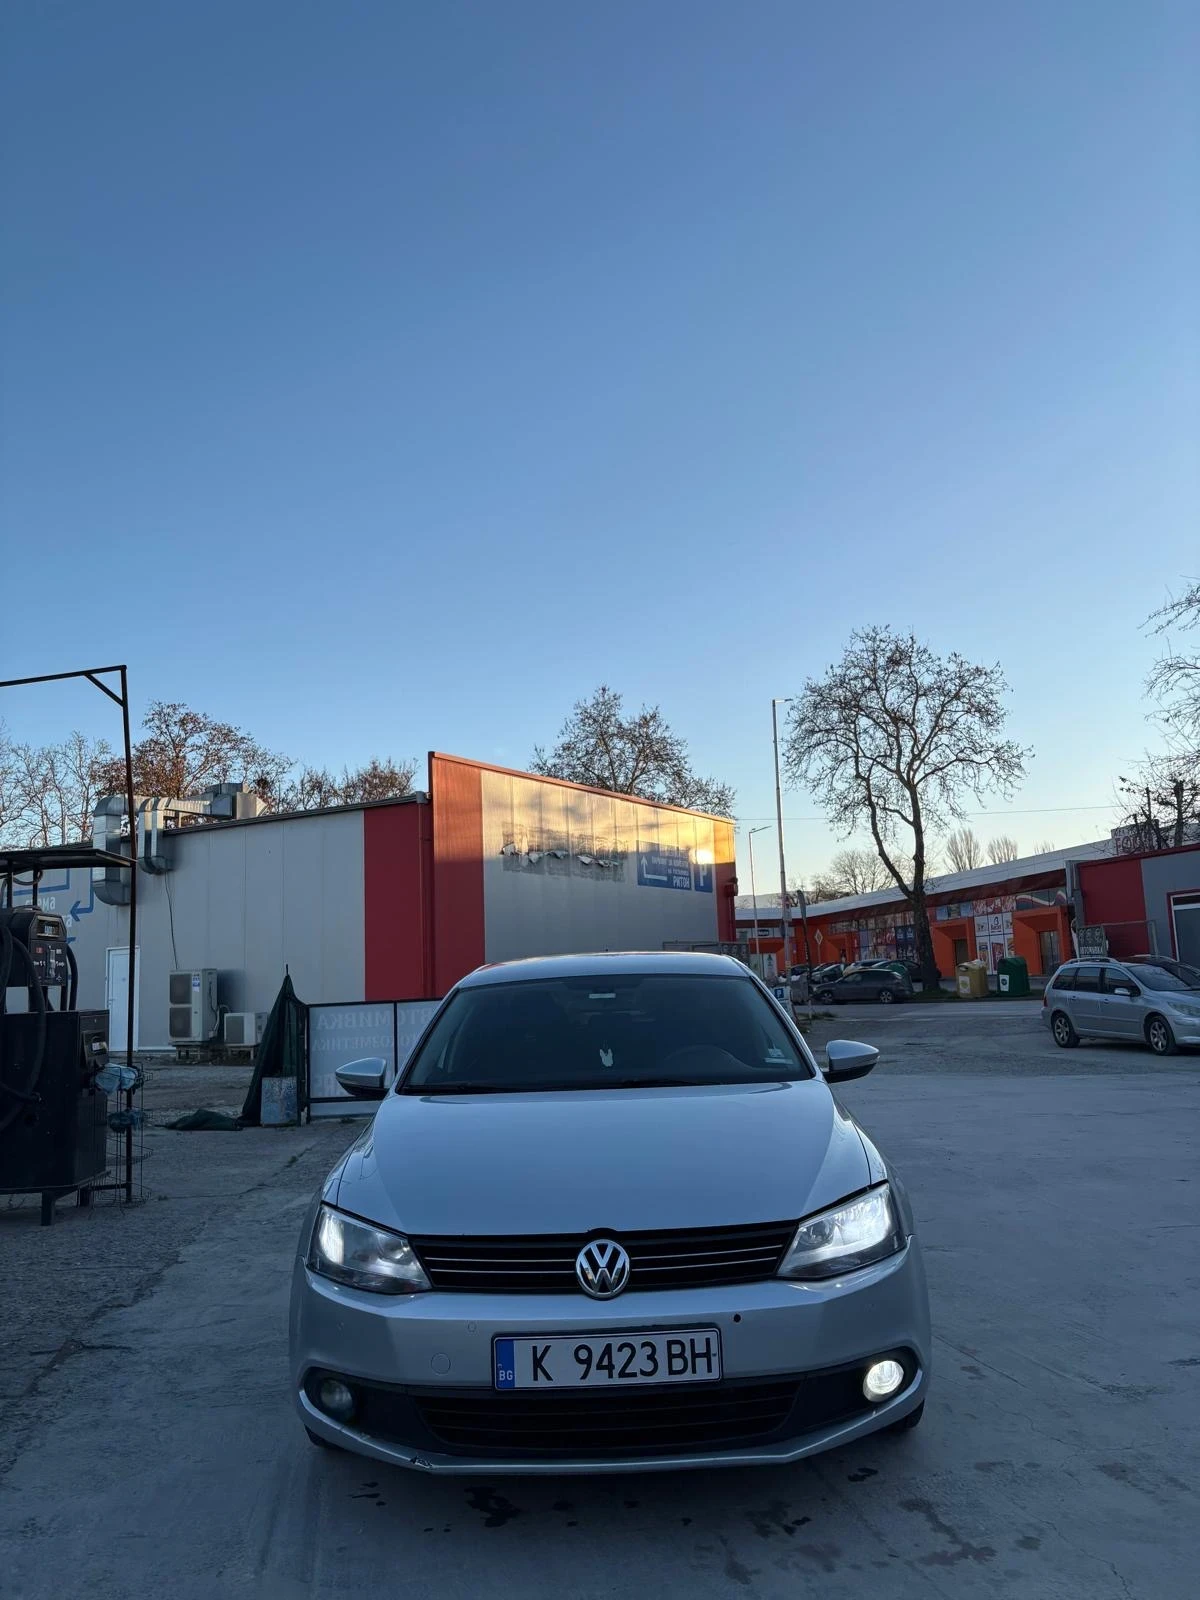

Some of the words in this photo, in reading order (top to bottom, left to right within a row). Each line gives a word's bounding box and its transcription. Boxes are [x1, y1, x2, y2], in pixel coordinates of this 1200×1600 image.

[577, 1239, 629, 1298] VW
[499, 1369, 513, 1381] BG
[532, 1345, 553, 1381] K
[573, 1340, 659, 1380] 9423
[667, 1337, 713, 1376] BH
